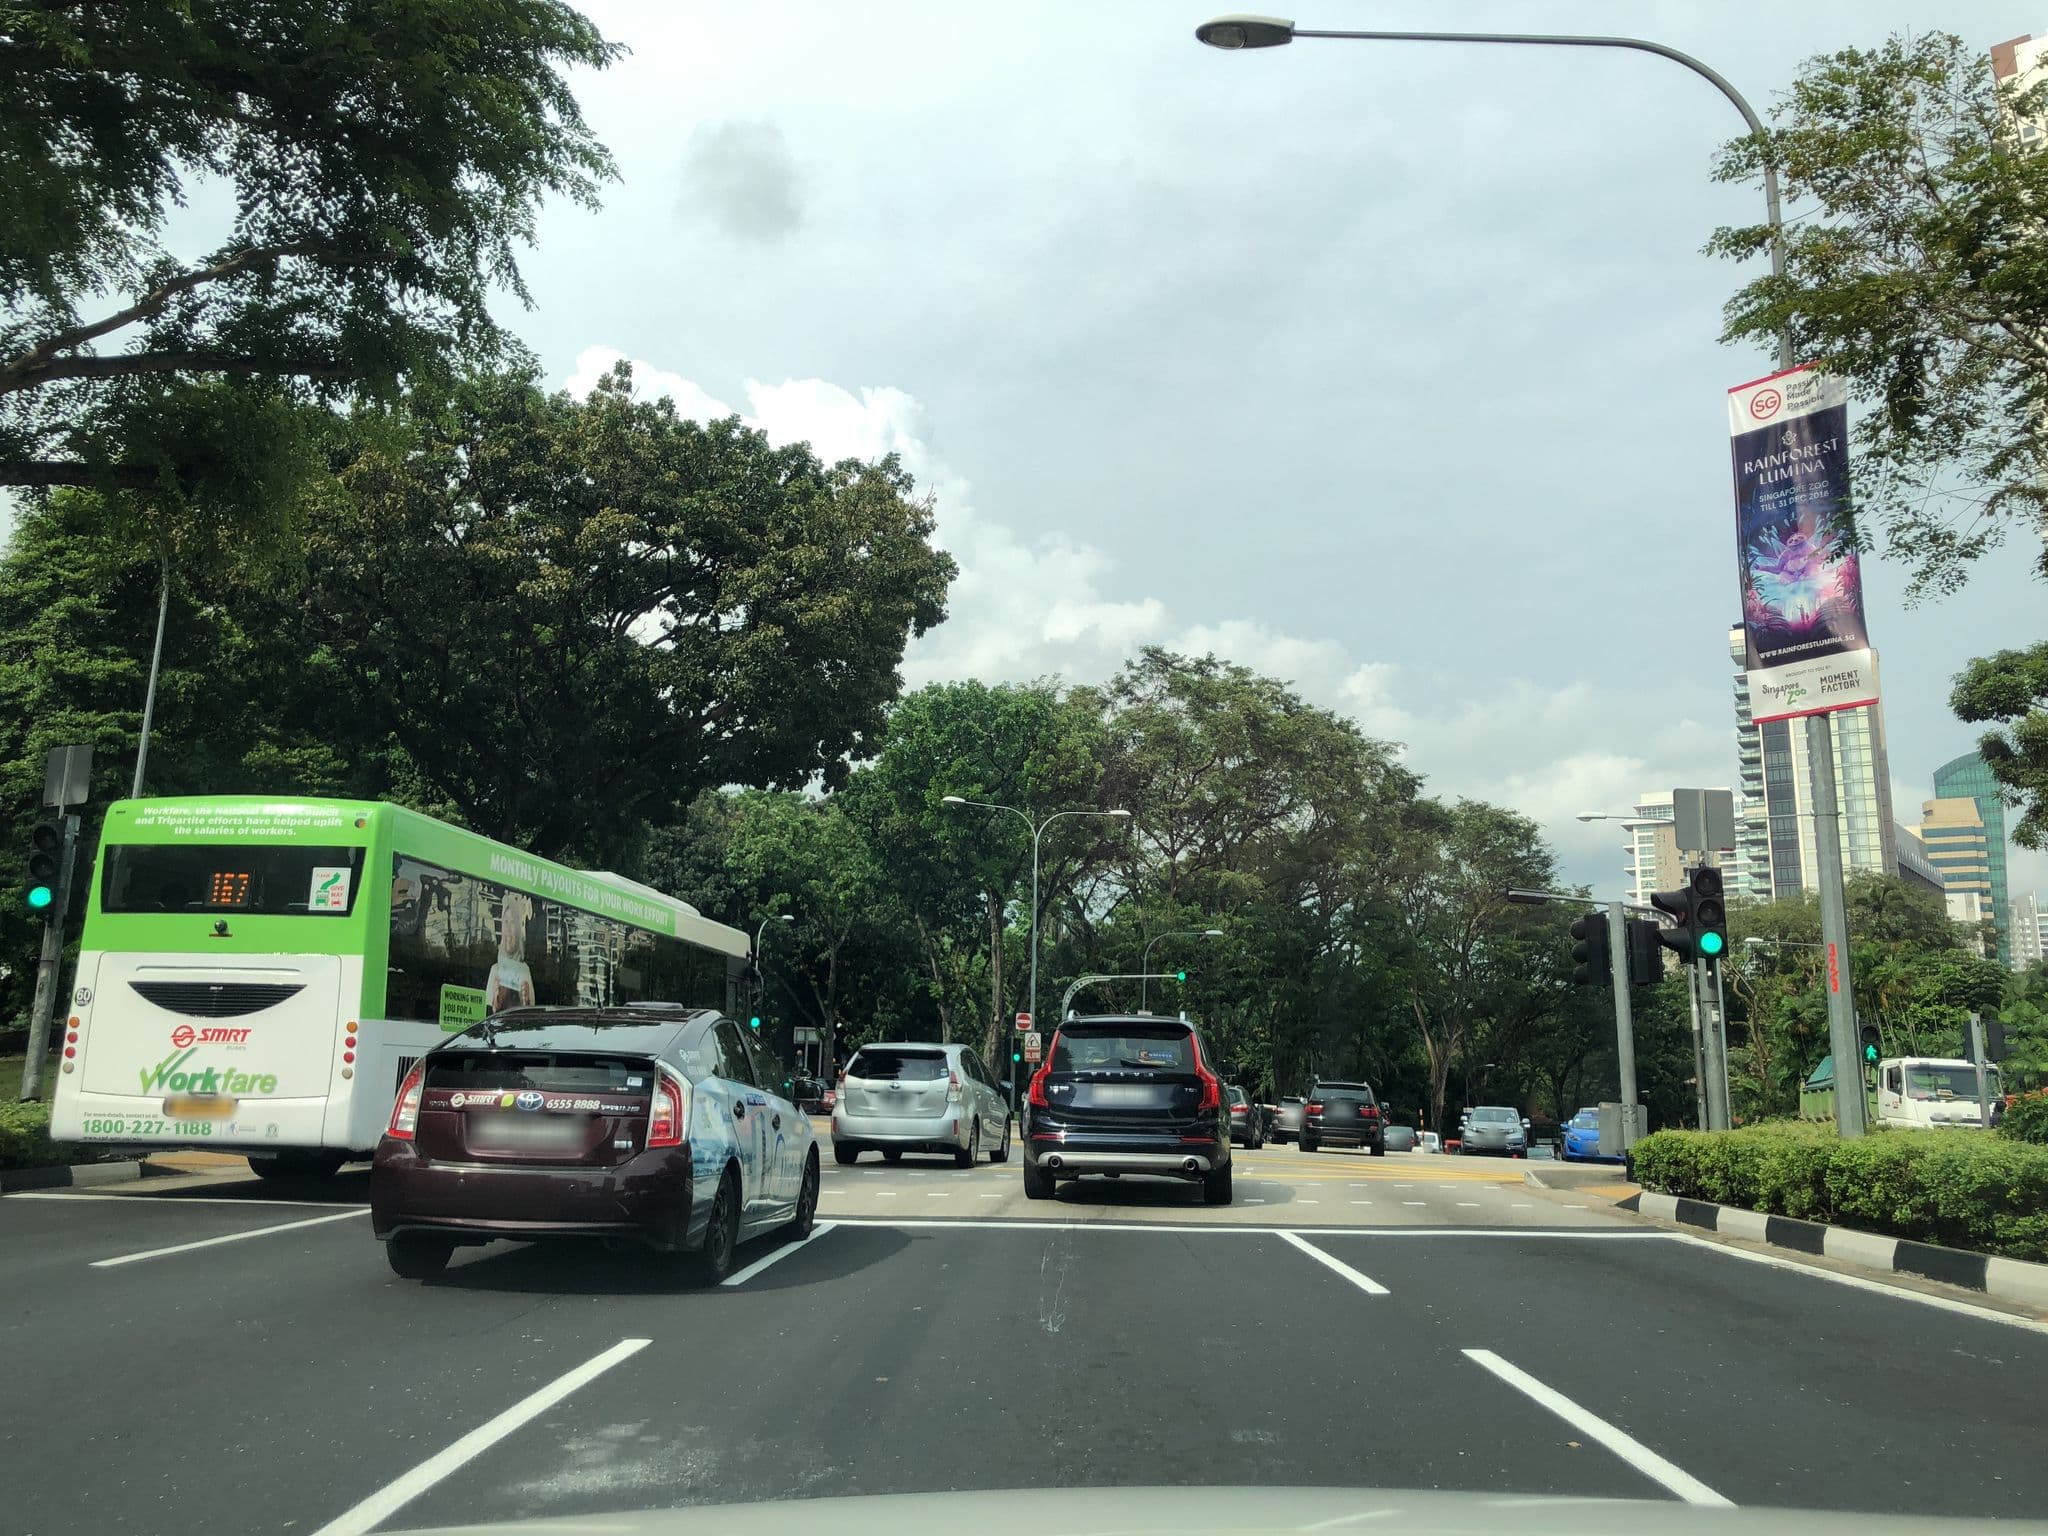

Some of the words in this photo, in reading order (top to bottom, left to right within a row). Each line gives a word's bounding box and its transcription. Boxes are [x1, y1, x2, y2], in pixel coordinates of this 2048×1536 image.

[1786, 388, 1811, 401] Made
[1787, 394, 1825, 410] Possible
[1755, 396, 1777, 413] SG
[1744, 437, 1838, 474] RAINFOREST
[1760, 459, 1825, 485] LUMINA
[1759, 484, 1807, 502] SINGAPORE
[1808, 480, 1829, 491] ZOO
[1760, 503, 1777, 512] TILL
[1778, 499, 1788, 508] 31
[1788, 495, 1807, 504] DEC
[1760, 634, 1855, 659] WWW.RAINFORESTLUMINA.SG
[1820, 669, 1858, 685] MOMENT
[1762, 682, 1799, 699] Singapore
[1821, 679, 1860, 693] FACTORY
[135, 817, 155, 825] and
[158, 816, 206, 826] Tripartite
[208, 817, 243, 825] efforts
[246, 817, 271, 825] have
[273, 817, 311, 827] helped
[313, 818, 343, 827] uplift
[174, 826, 192, 835] the
[194, 826, 235, 835] salaries
[238, 826, 250, 835] of
[251, 826, 297, 836] workers.
[490, 853, 539, 887] MONTHLY
[541, 868, 582, 897] PAYOUTS
[77, 989, 91, 1000] 60
[198, 1027, 252, 1043] SMRT
[139, 1047, 279, 1095] Workfare
[467, 1094, 498, 1104] SMRT
[546, 1098, 572, 1109] 6555
[573, 1099, 600, 1110] 8888
[82, 1119, 212, 1137] 1800-227-1188
